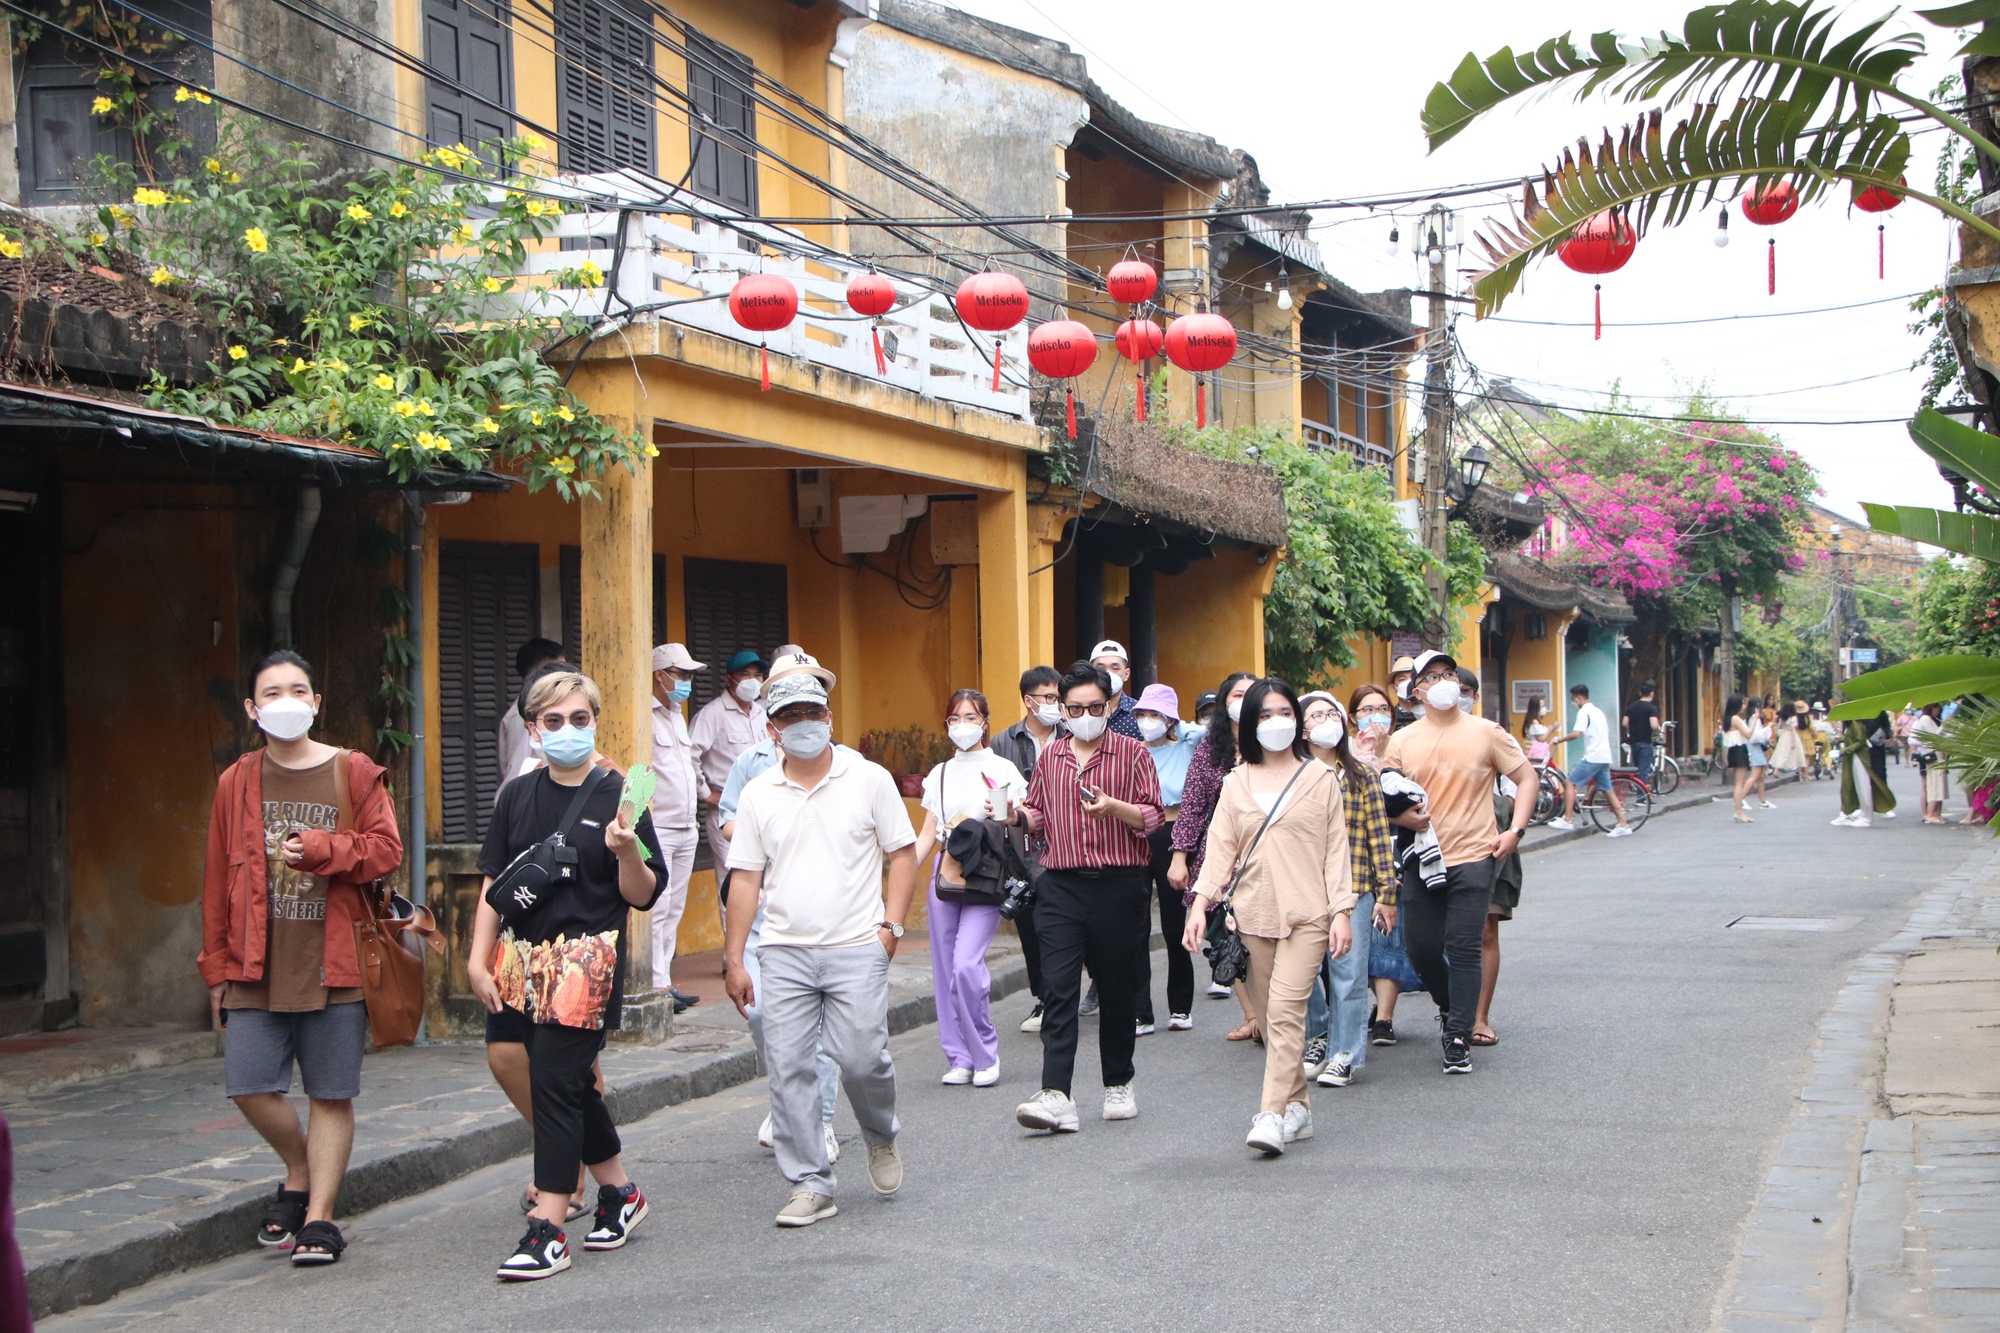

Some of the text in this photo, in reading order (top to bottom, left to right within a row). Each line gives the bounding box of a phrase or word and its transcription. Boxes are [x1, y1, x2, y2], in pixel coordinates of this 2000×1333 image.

[1110, 274, 1146, 285] Metiseko
[739, 294, 786, 308] Metiseko
[975, 294, 1022, 307] Metiseko
[1029, 338, 1071, 354] Metiseko
[1187, 334, 1232, 348] Metiseko
[794, 653, 811, 665] LA
[282, 802, 338, 828] BUCK
[514, 886, 537, 909] NY
[286, 902, 326, 919] HERE
